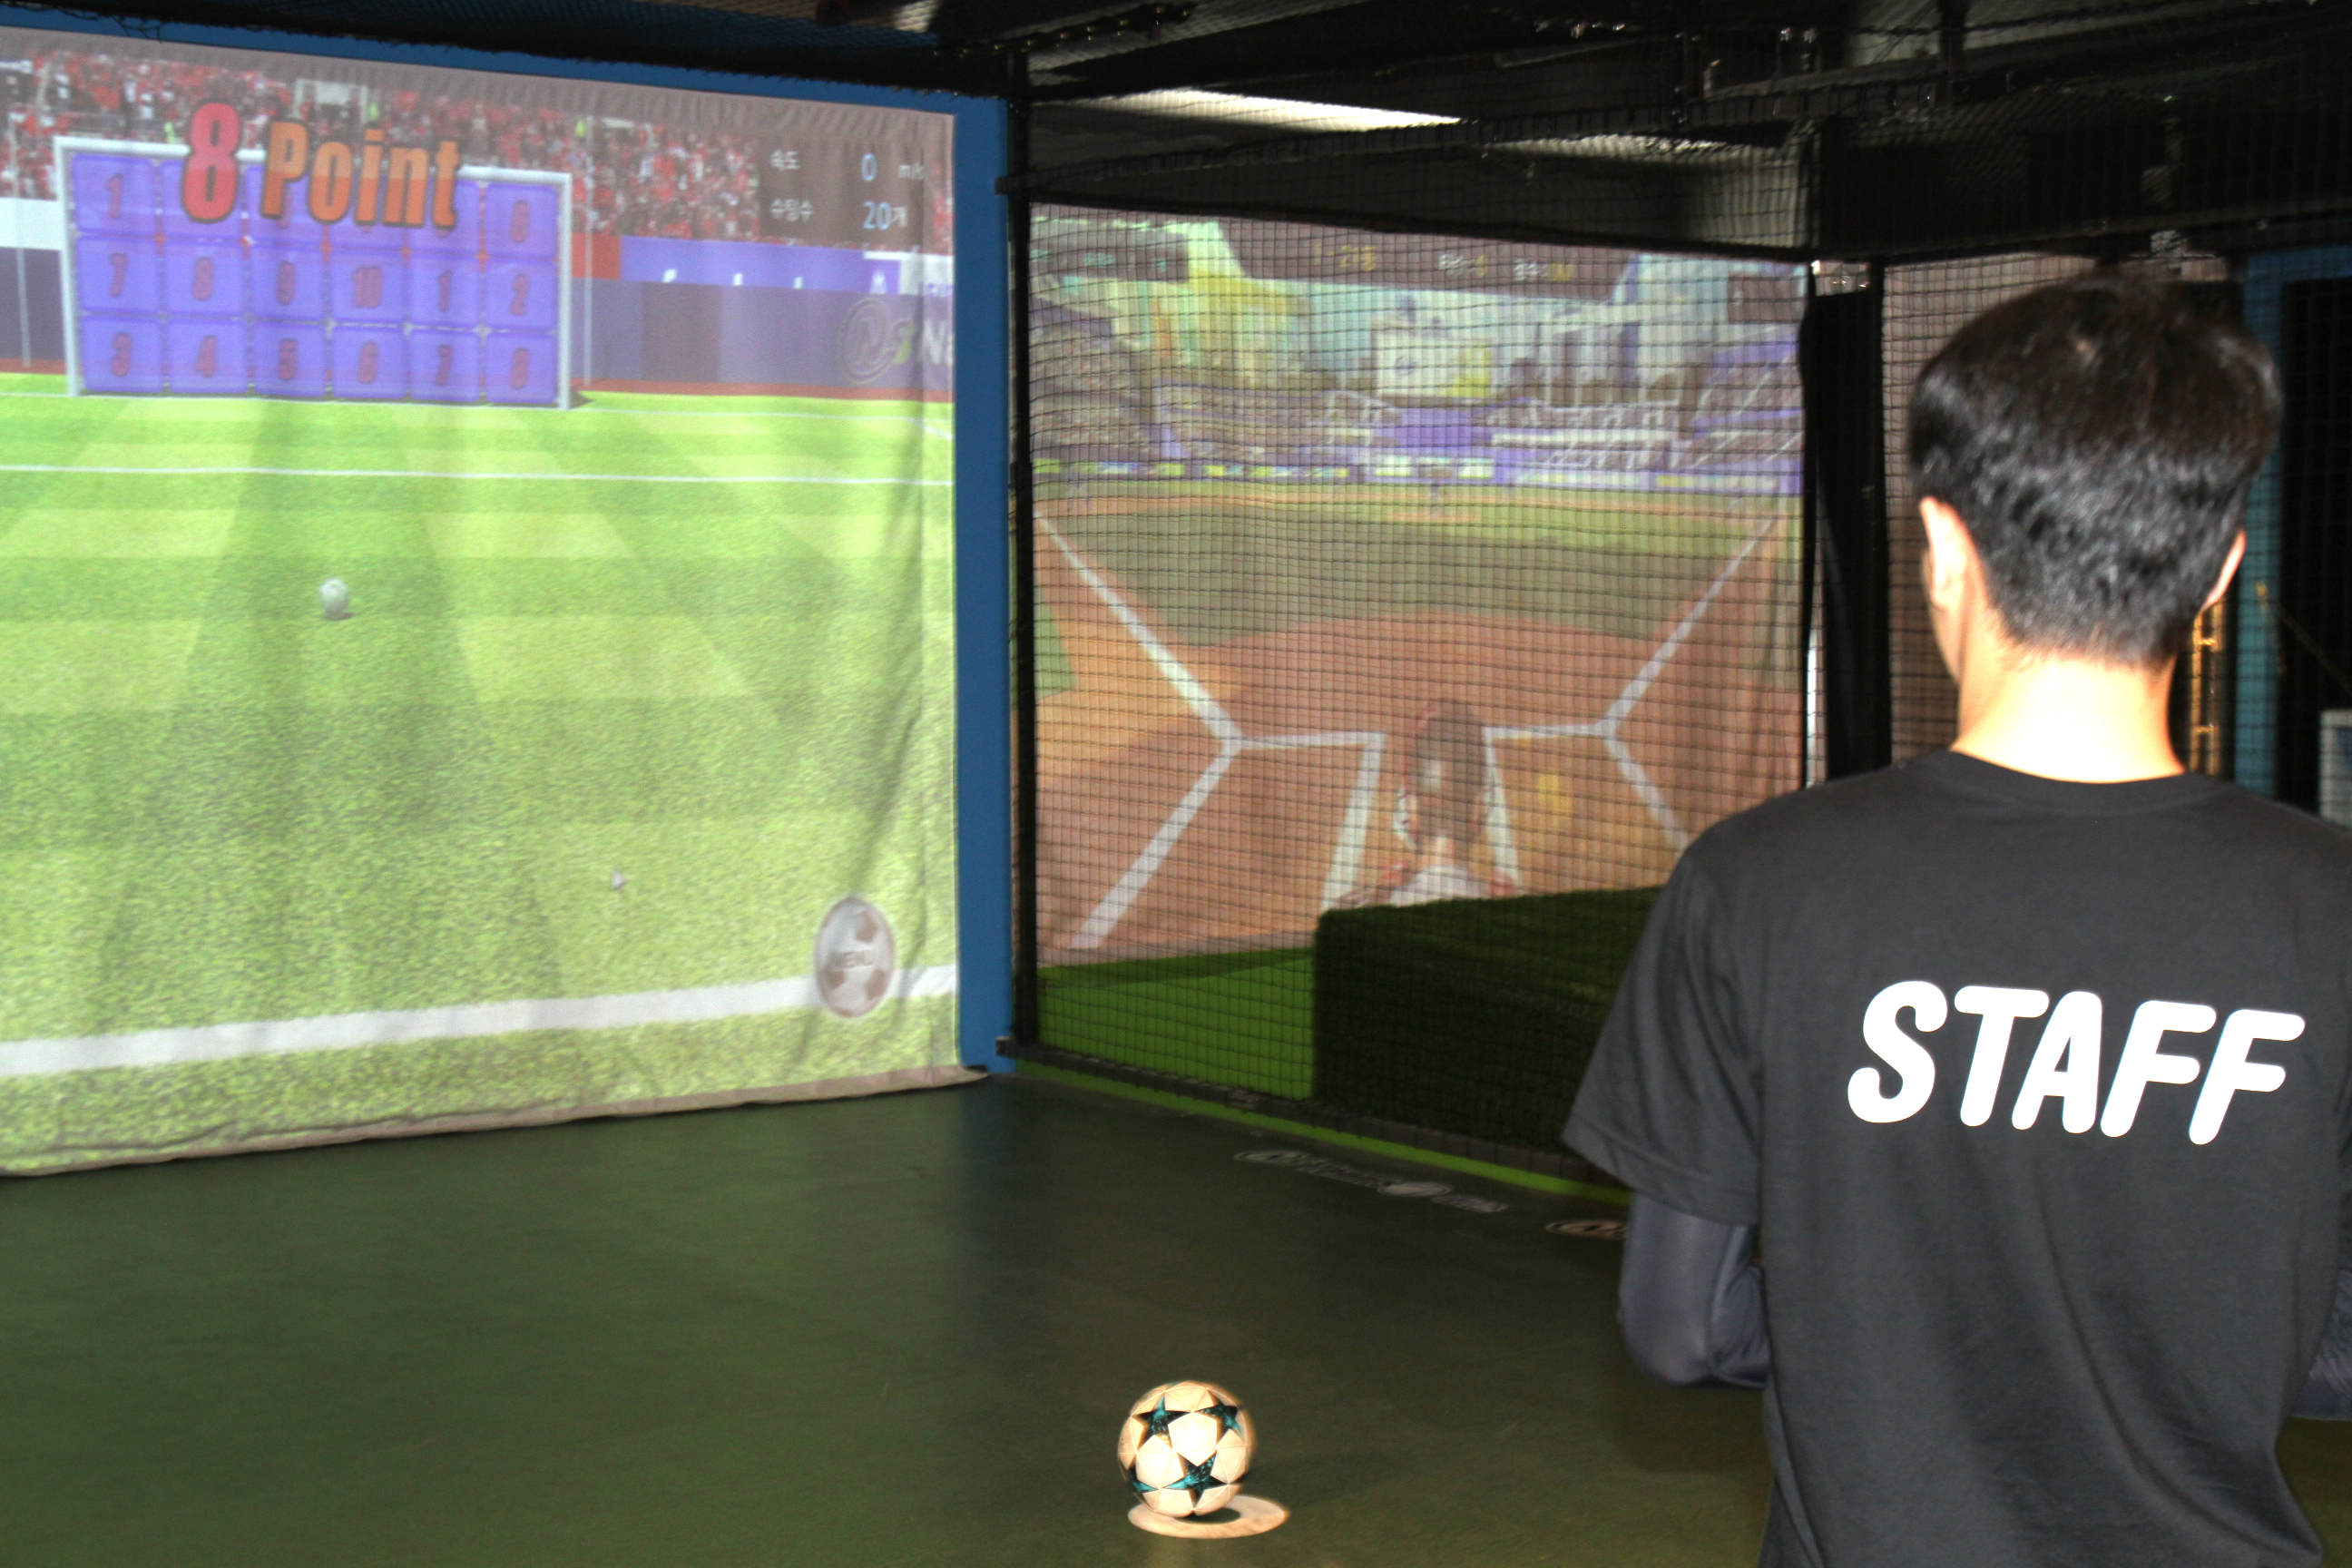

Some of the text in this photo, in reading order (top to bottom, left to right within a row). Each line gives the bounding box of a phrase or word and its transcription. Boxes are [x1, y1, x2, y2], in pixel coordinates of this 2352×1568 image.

[181, 97, 464, 230] 8 Point
[1847, 980, 2306, 1145] STAFF
